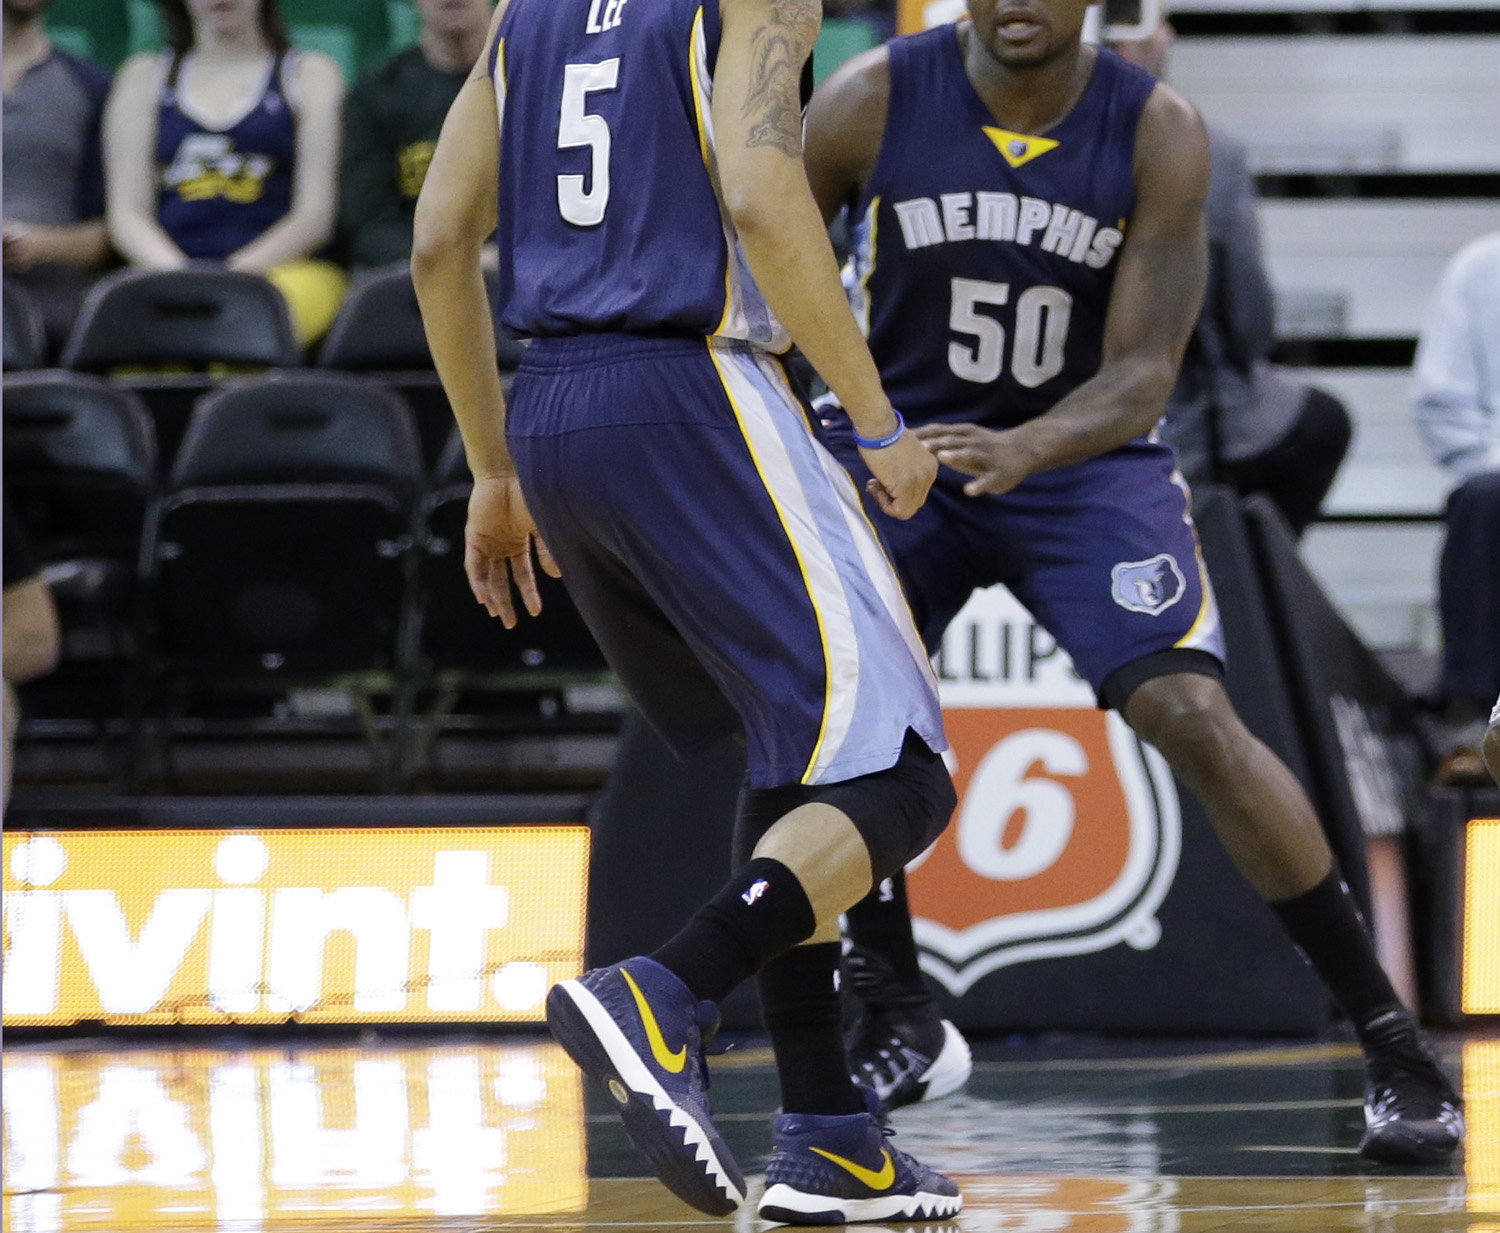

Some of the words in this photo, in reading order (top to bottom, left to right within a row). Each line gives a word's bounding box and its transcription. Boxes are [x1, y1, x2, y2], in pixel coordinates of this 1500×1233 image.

[557, 58, 620, 227] 5
[893, 191, 1124, 268] MEMPHIS
[948, 277, 1073, 388] 50
[939, 623, 1088, 681] LLIP
[944, 727, 1090, 882] 6
[3, 834, 548, 1014] ivint.
